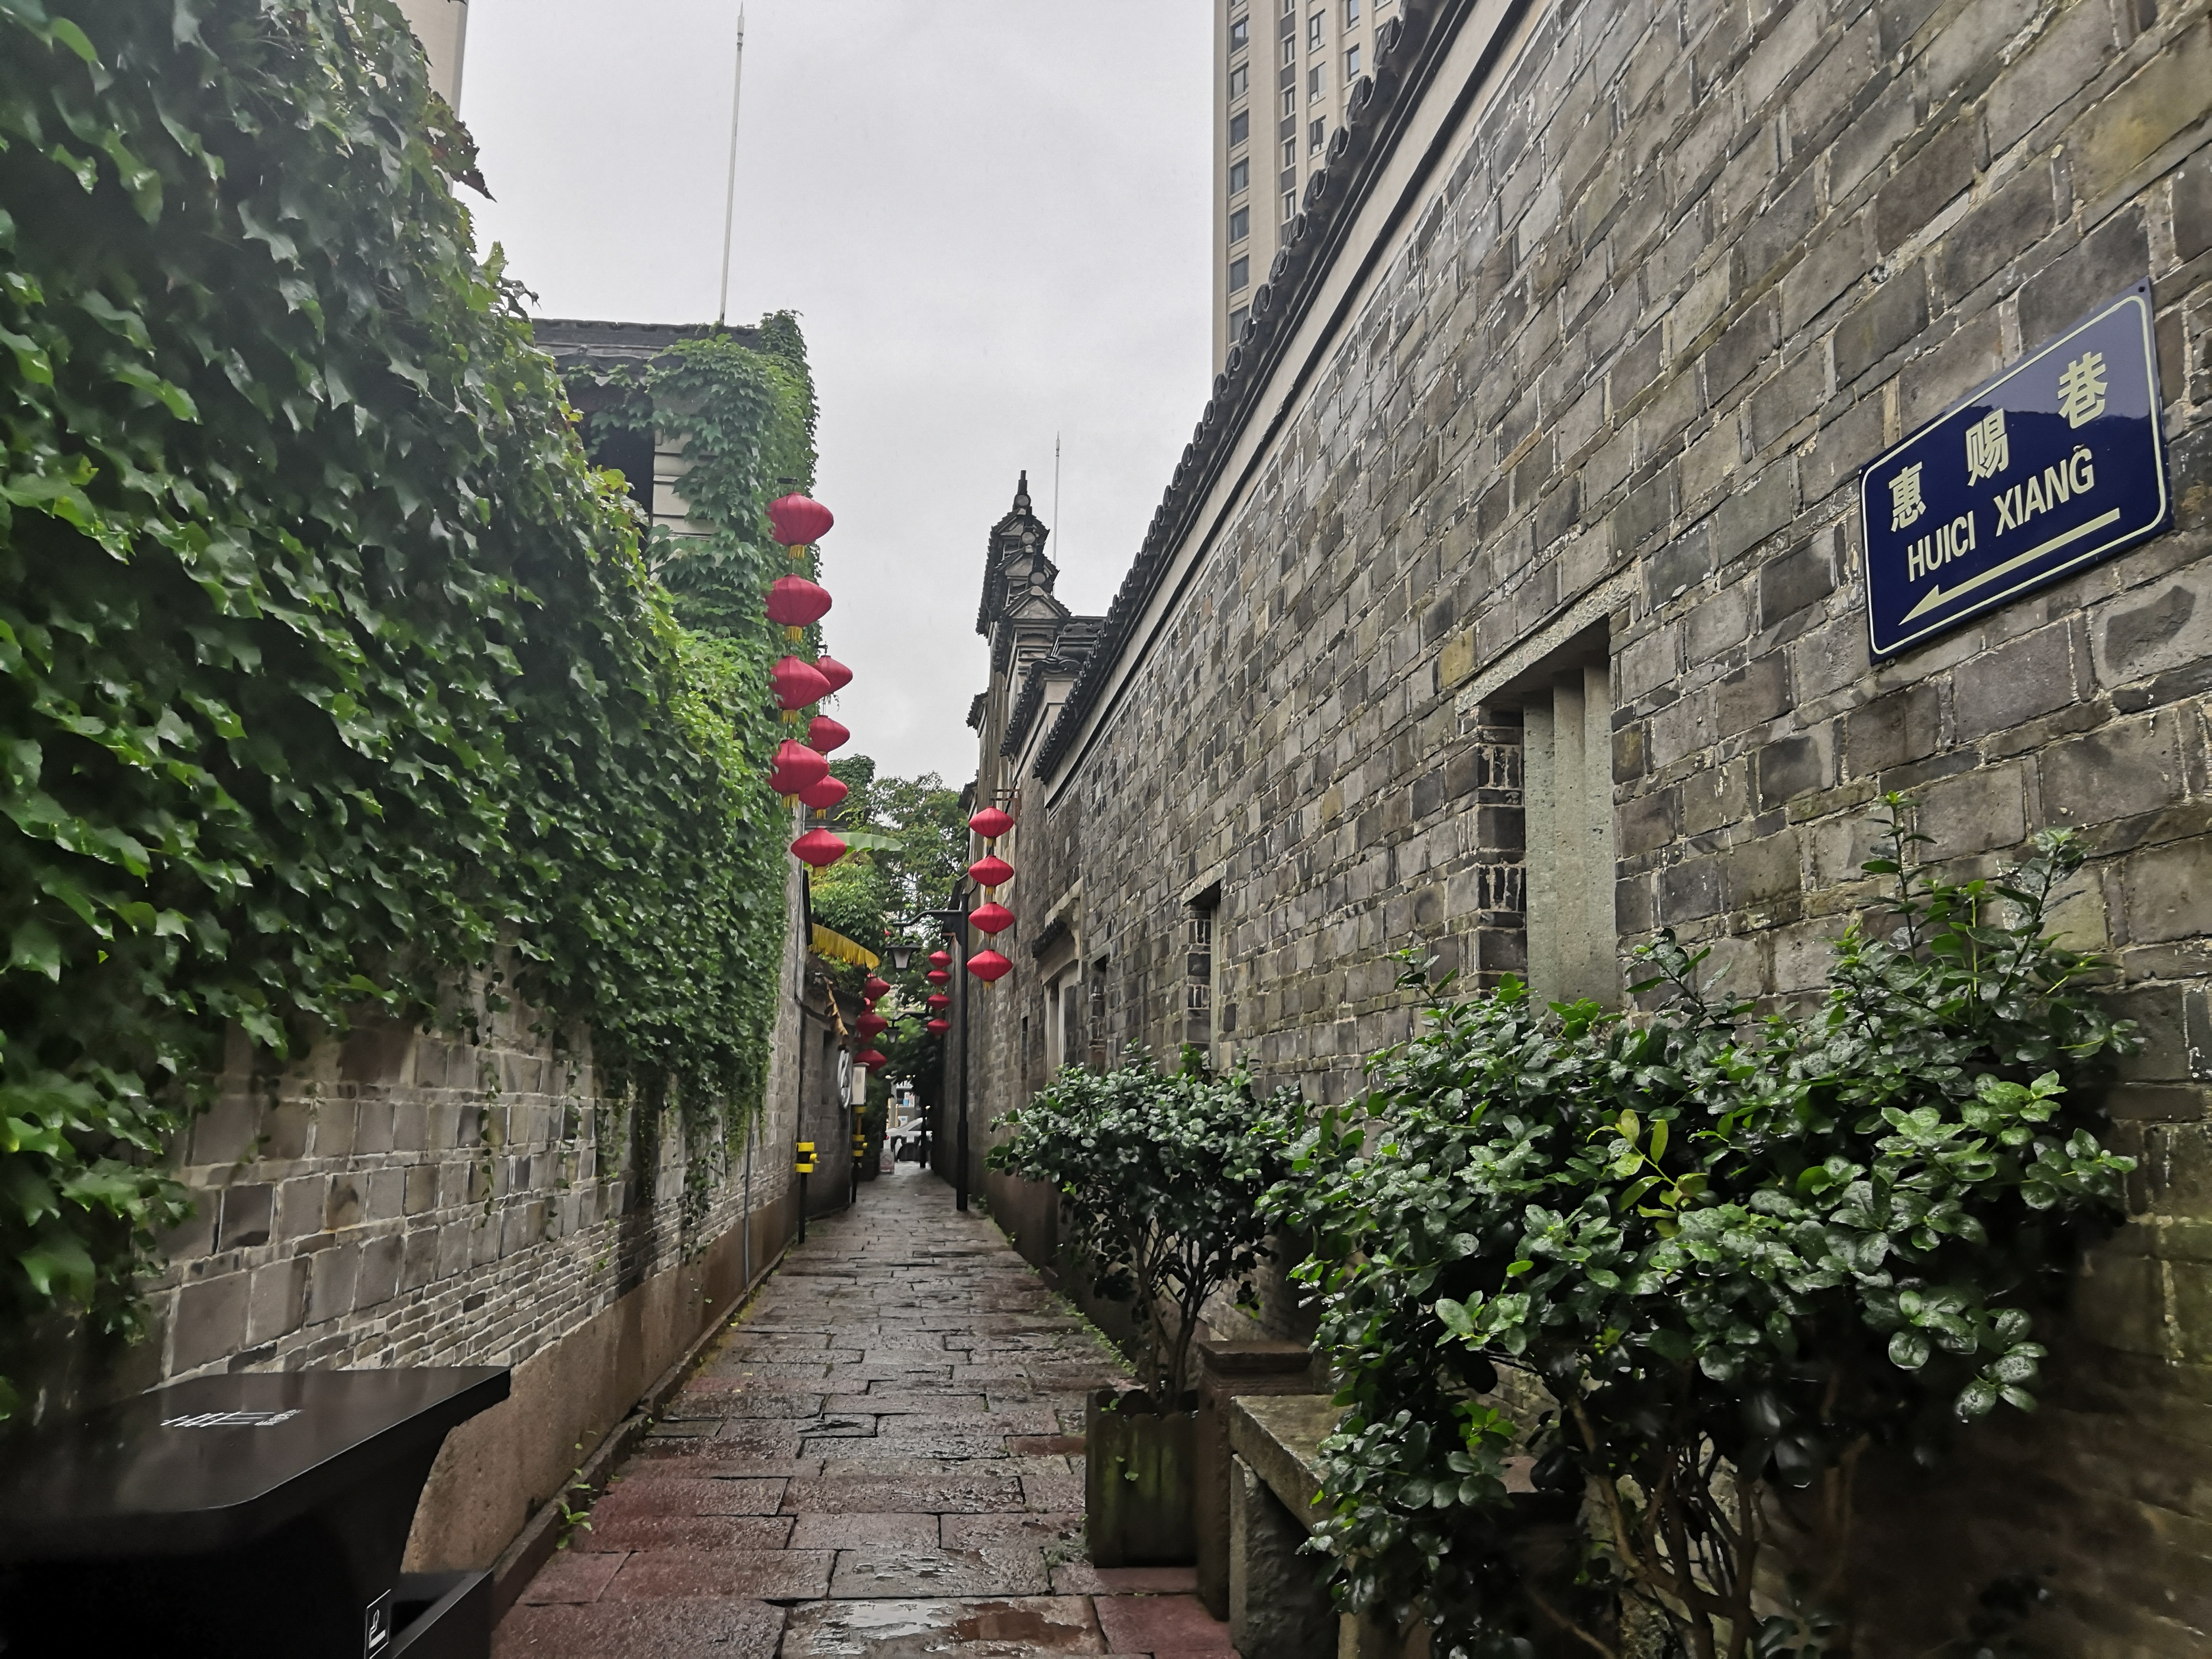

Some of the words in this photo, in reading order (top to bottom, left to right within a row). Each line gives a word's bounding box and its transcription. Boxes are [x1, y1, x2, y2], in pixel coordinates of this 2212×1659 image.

[1888, 351, 2108, 532] 惠赐巷
[1907, 510, 1976, 582] HUICI
[1993, 447, 2095, 537] XIANG
